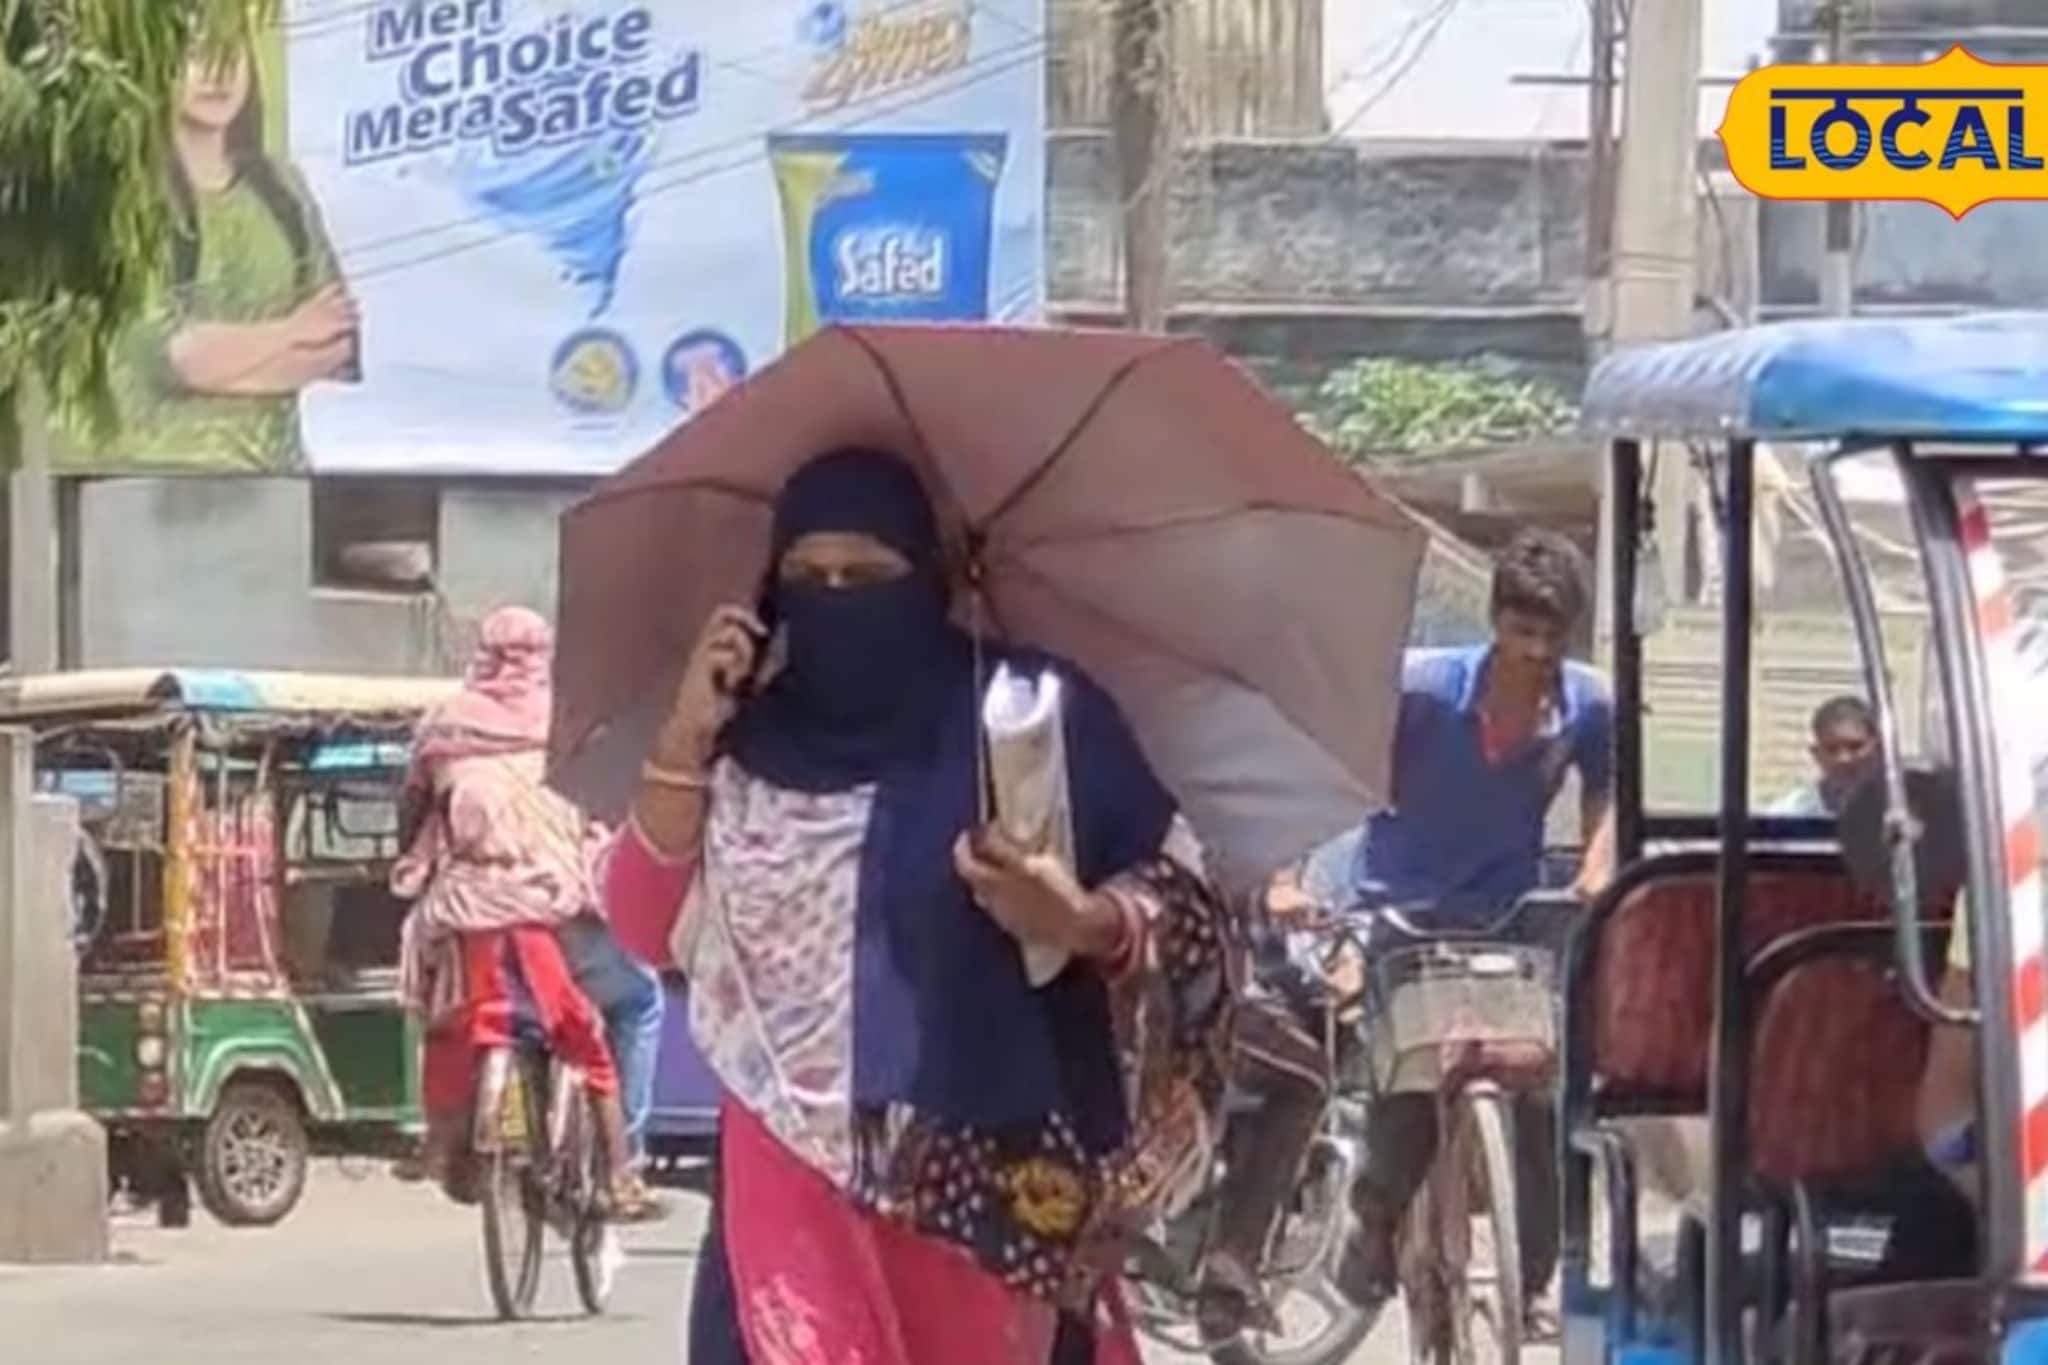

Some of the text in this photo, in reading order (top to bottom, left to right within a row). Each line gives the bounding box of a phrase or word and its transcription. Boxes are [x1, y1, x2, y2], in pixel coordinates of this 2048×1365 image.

[371, 0, 502, 52] Meri
[406, 7, 653, 99] Choice
[350, 50, 701, 154] Mera Safed
[838, 233, 944, 297] Safed
